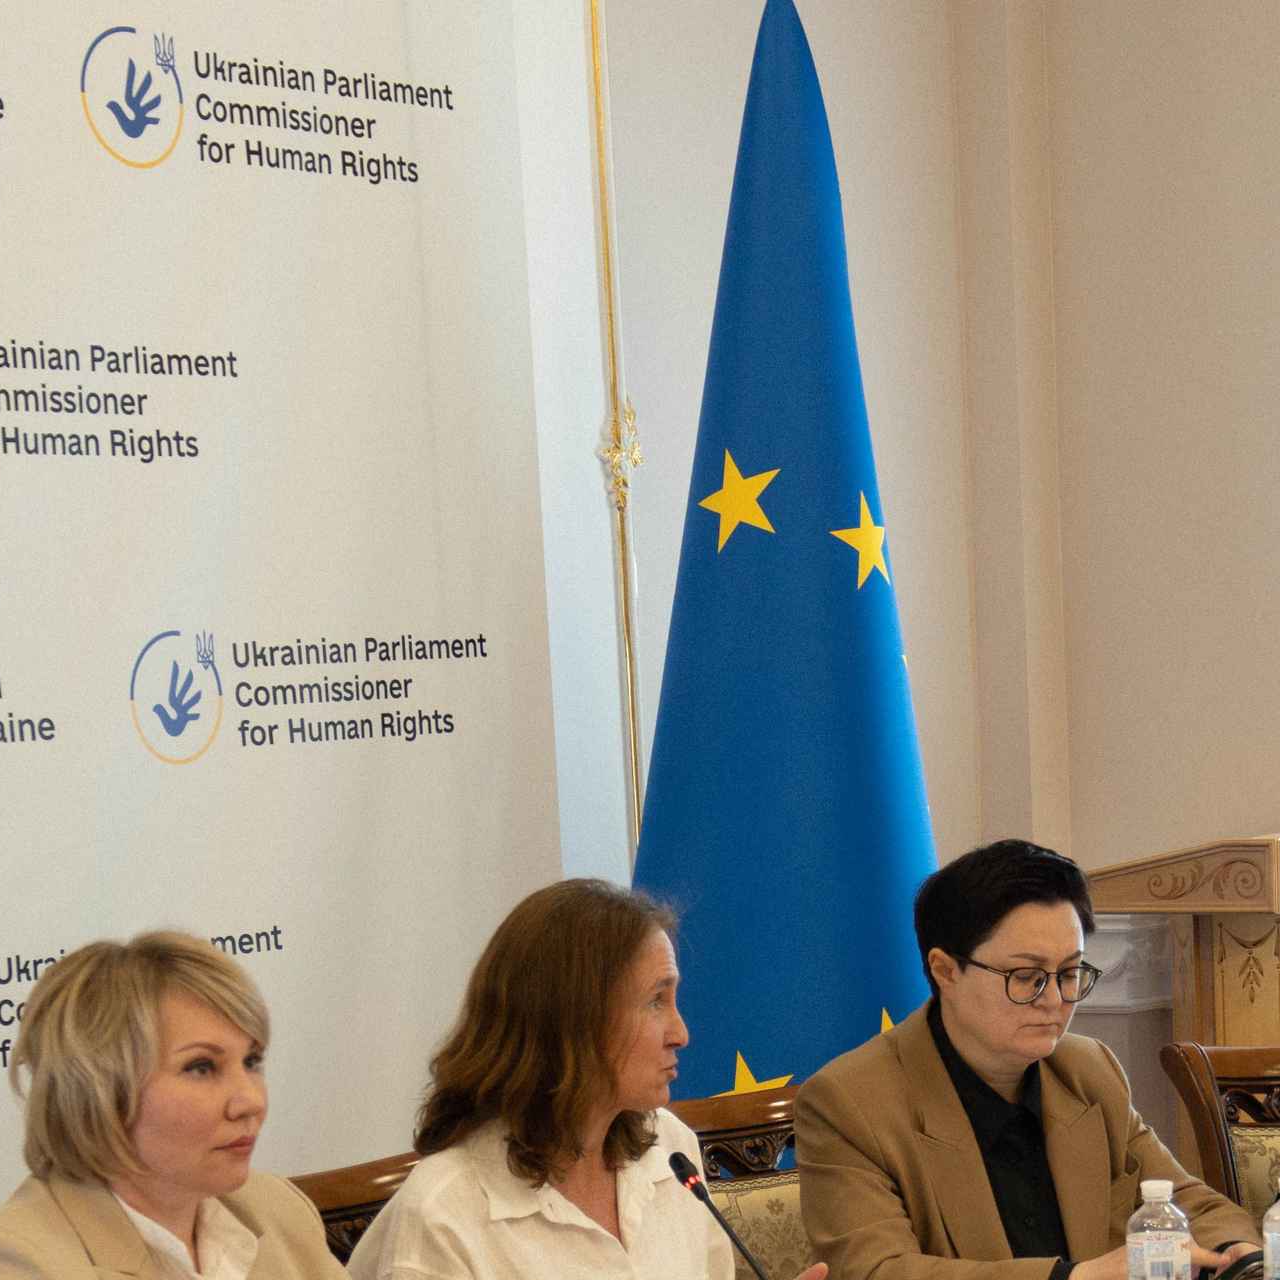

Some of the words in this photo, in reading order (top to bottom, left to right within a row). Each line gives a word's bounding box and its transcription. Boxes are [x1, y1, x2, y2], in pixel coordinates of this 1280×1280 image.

[193, 50, 316, 93] Ukrainian
[323, 68, 454, 111] Parliament
[195, 92, 377, 139] Commissioner
[196, 132, 236, 165] for
[244, 139, 333, 175] Human
[340, 150, 419, 186] Rights
[89, 344, 239, 378] Parliament
[0, 426, 101, 457] Human
[109, 428, 200, 464] Rights
[232, 637, 358, 669] Ukrainian
[364, 633, 488, 663] Parliament
[235, 674, 413, 708] Commissioner
[237, 719, 279, 747] for
[287, 717, 374, 744] Human
[380, 709, 455, 743] Rights
